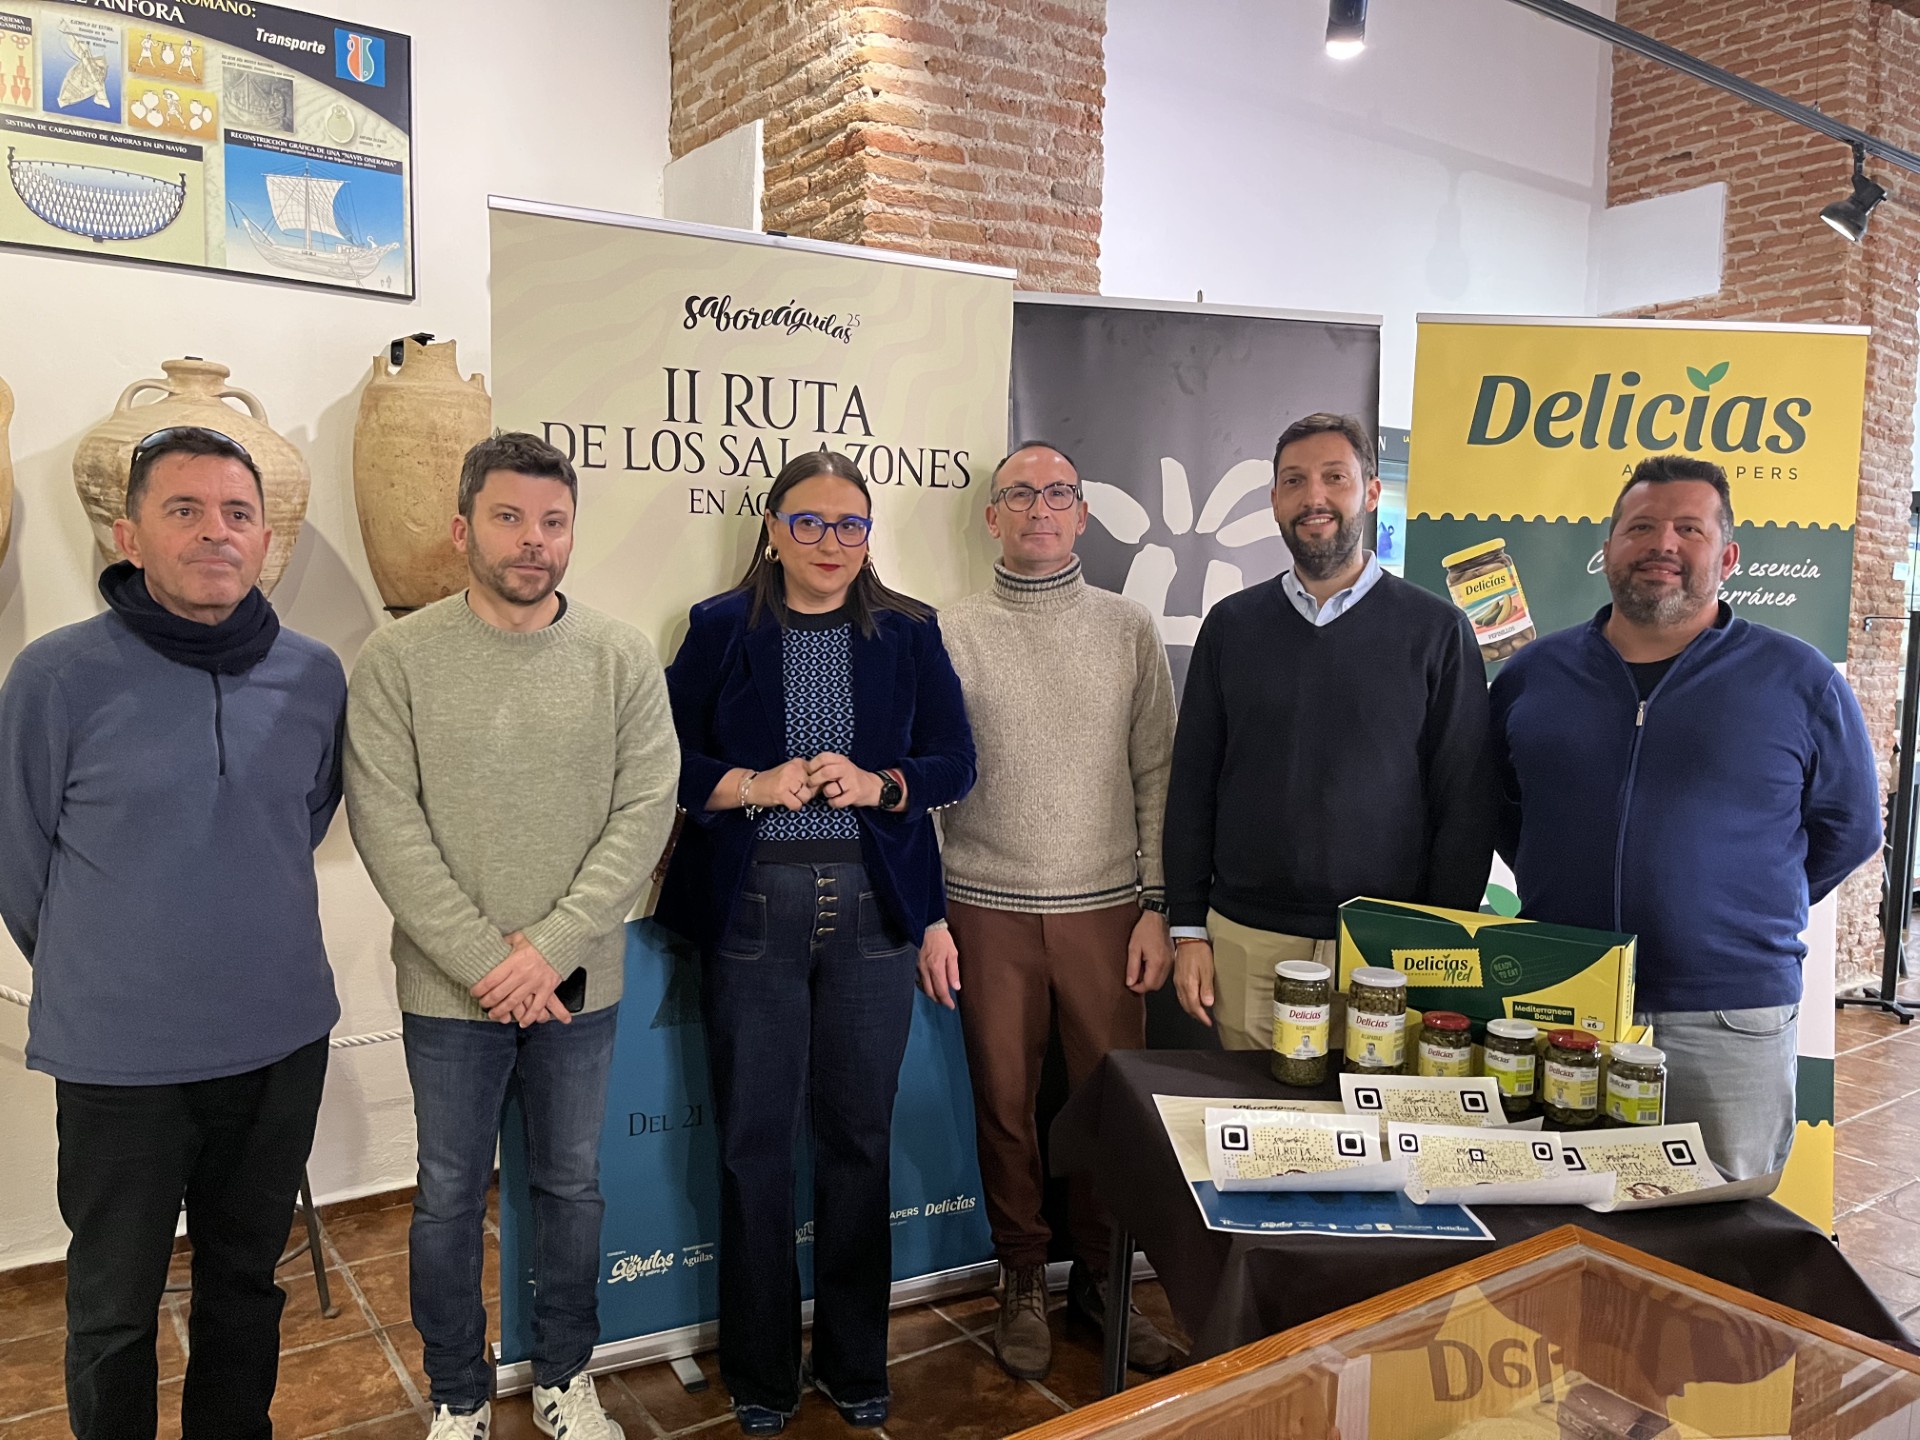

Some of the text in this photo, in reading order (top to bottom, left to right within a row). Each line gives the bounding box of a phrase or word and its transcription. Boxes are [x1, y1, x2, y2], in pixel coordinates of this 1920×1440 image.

[176, 0, 256, 18] OMANO:
[256, 27, 326, 55] Transporte
[5, 119, 35, 129] SISTEMA
[49, 126, 97, 140] CARGAMENTO
[99, 133, 108, 141] DE
[110, 134, 142, 147] ÁNFORAS
[143, 139, 152, 148] EN
[154, 142, 164, 150] UN
[165, 143, 187, 153] NAVÍO
[230, 131, 288, 147] RECONSTRUCCIÓN
[289, 141, 315, 153] GRÁFICA
[326, 148, 341, 158] UNA
[847, 313, 861, 328] 25
[661, 366, 876, 437] II RUTA
[1466, 361, 1813, 454] Delicias
[540, 421, 971, 490] DE LOS SALZONES
[688, 487, 726, 516] EN
[1748, 558, 1821, 579] esencia
[1465, 574, 1506, 596] Delicias
[1717, 580, 1797, 606] terráneo
[1403, 953, 1469, 971] Delicias
[1442, 966, 1474, 984] Med
[1289, 1009, 1321, 1020] Delicias
[1514, 1004, 1573, 1016] Mediterranean
[1534, 1013, 1554, 1022] Bowl
[1356, 1015, 1389, 1028] Delicias
[681, 1104, 702, 1128] 21
[924, 1194, 976, 1217] Delicias
[682, 1252, 714, 1267] Águilas
